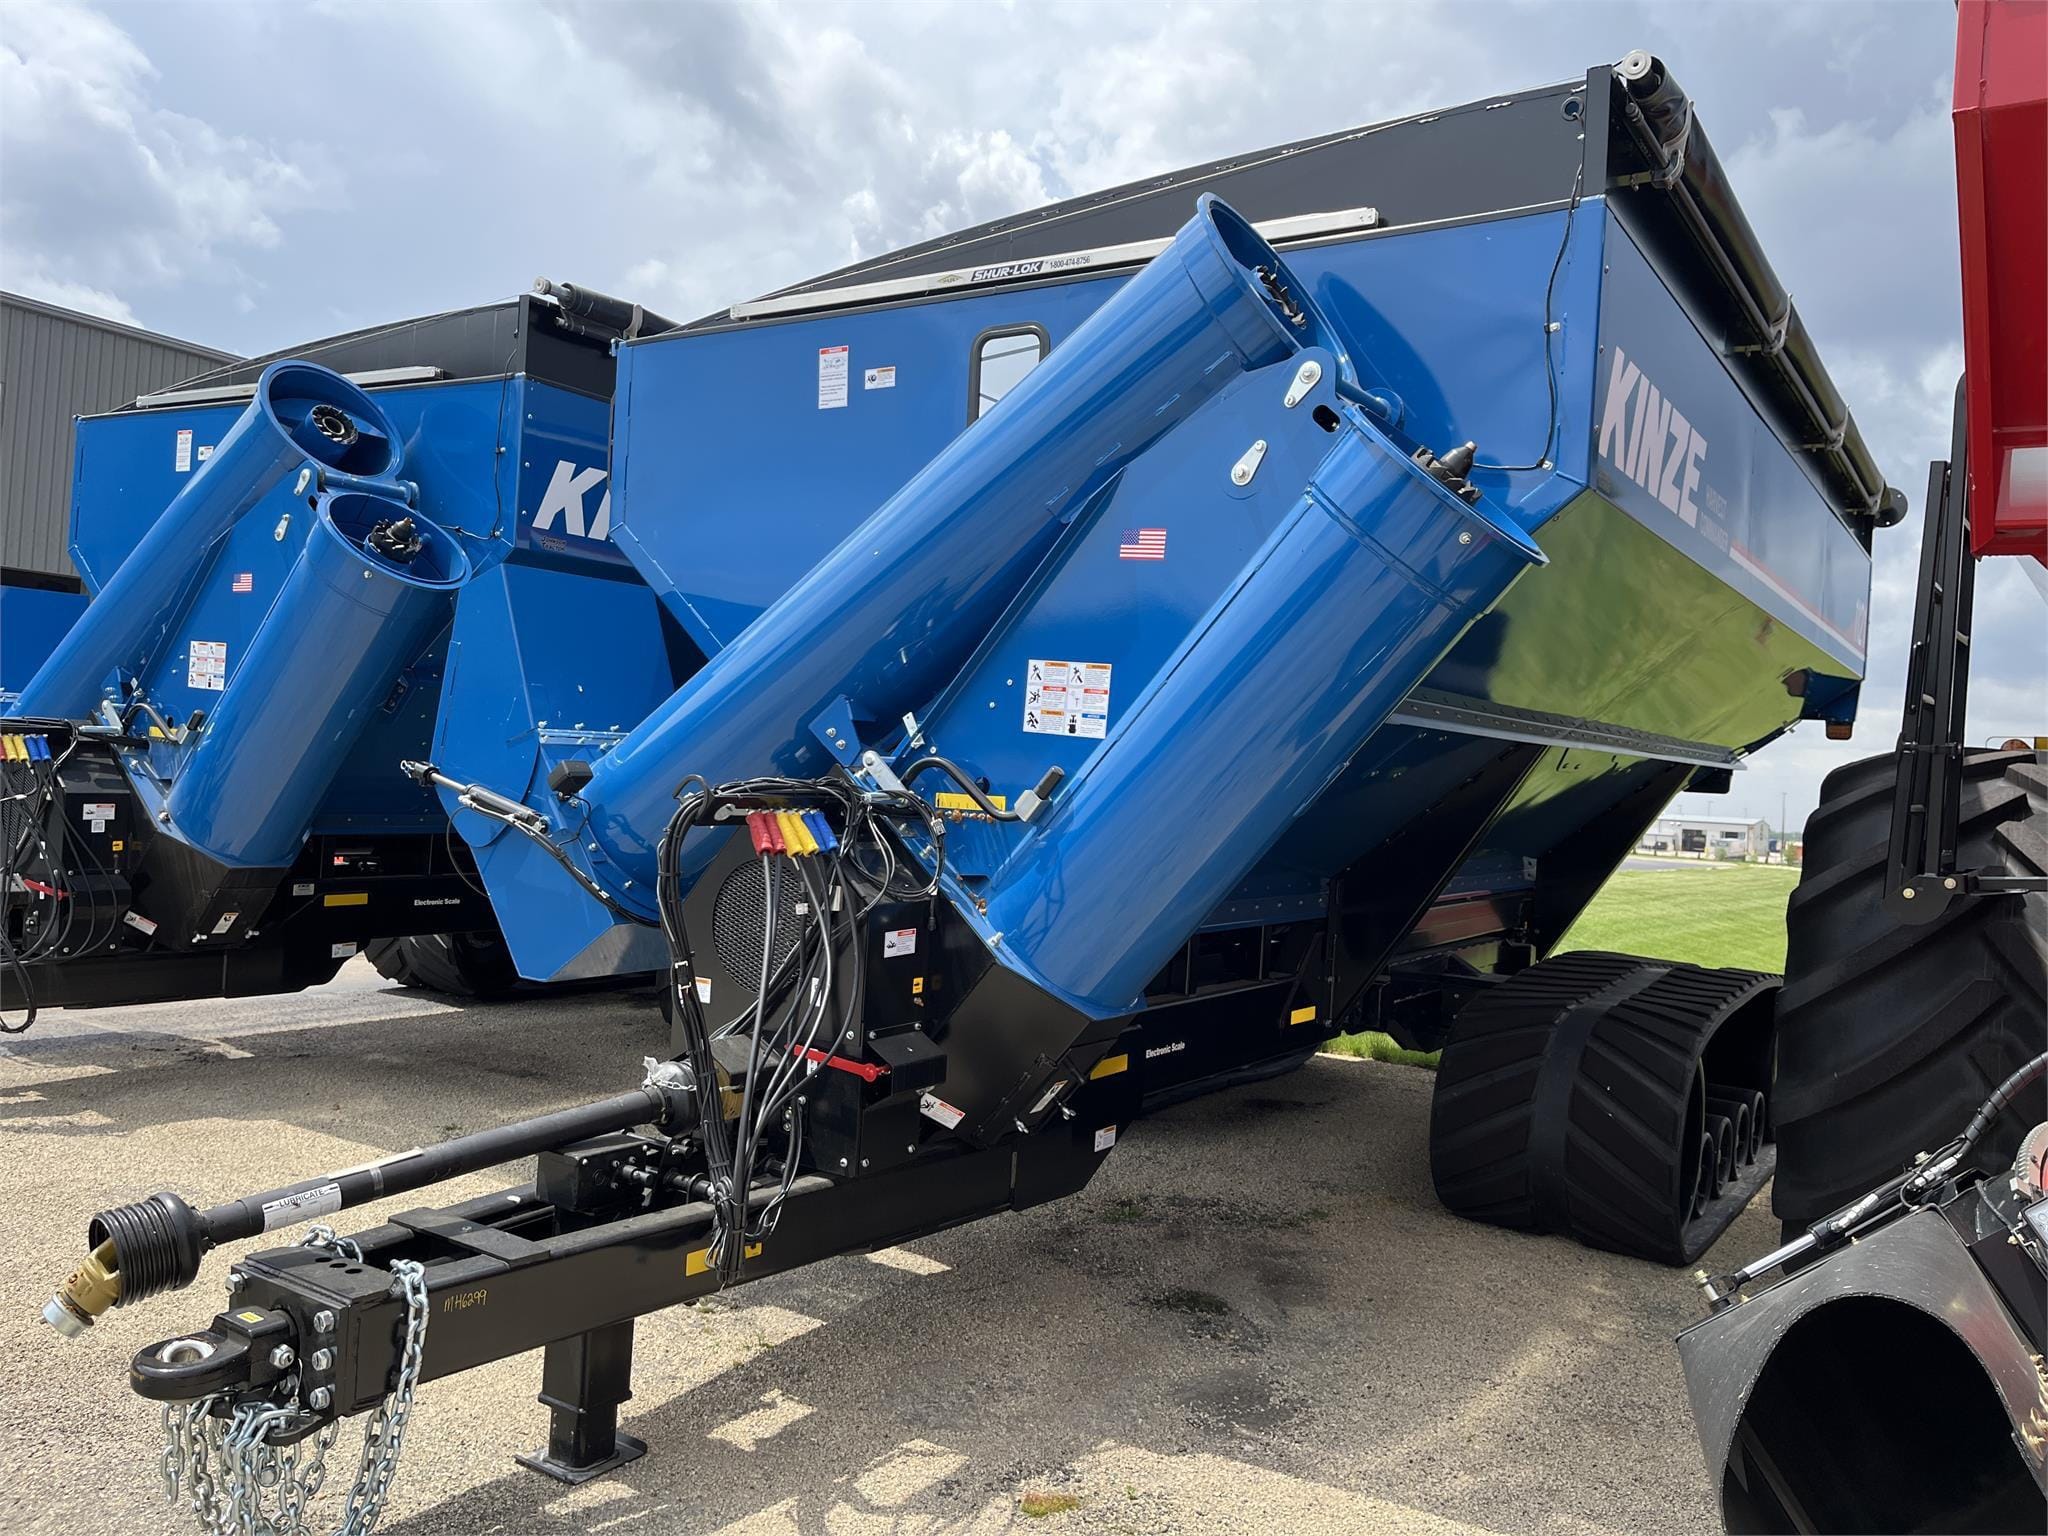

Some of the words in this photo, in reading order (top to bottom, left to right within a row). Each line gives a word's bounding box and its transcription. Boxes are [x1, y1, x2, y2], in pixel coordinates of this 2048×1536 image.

[1598, 346, 1708, 529] KINZE
[414, 898, 444, 906] Electronic
[1145, 1045, 1171, 1059] Electronic
[1171, 1041, 1186, 1052] Scale
[279, 1189, 325, 1208] LUBRICATE
[443, 1289, 487, 1312] MH6299
